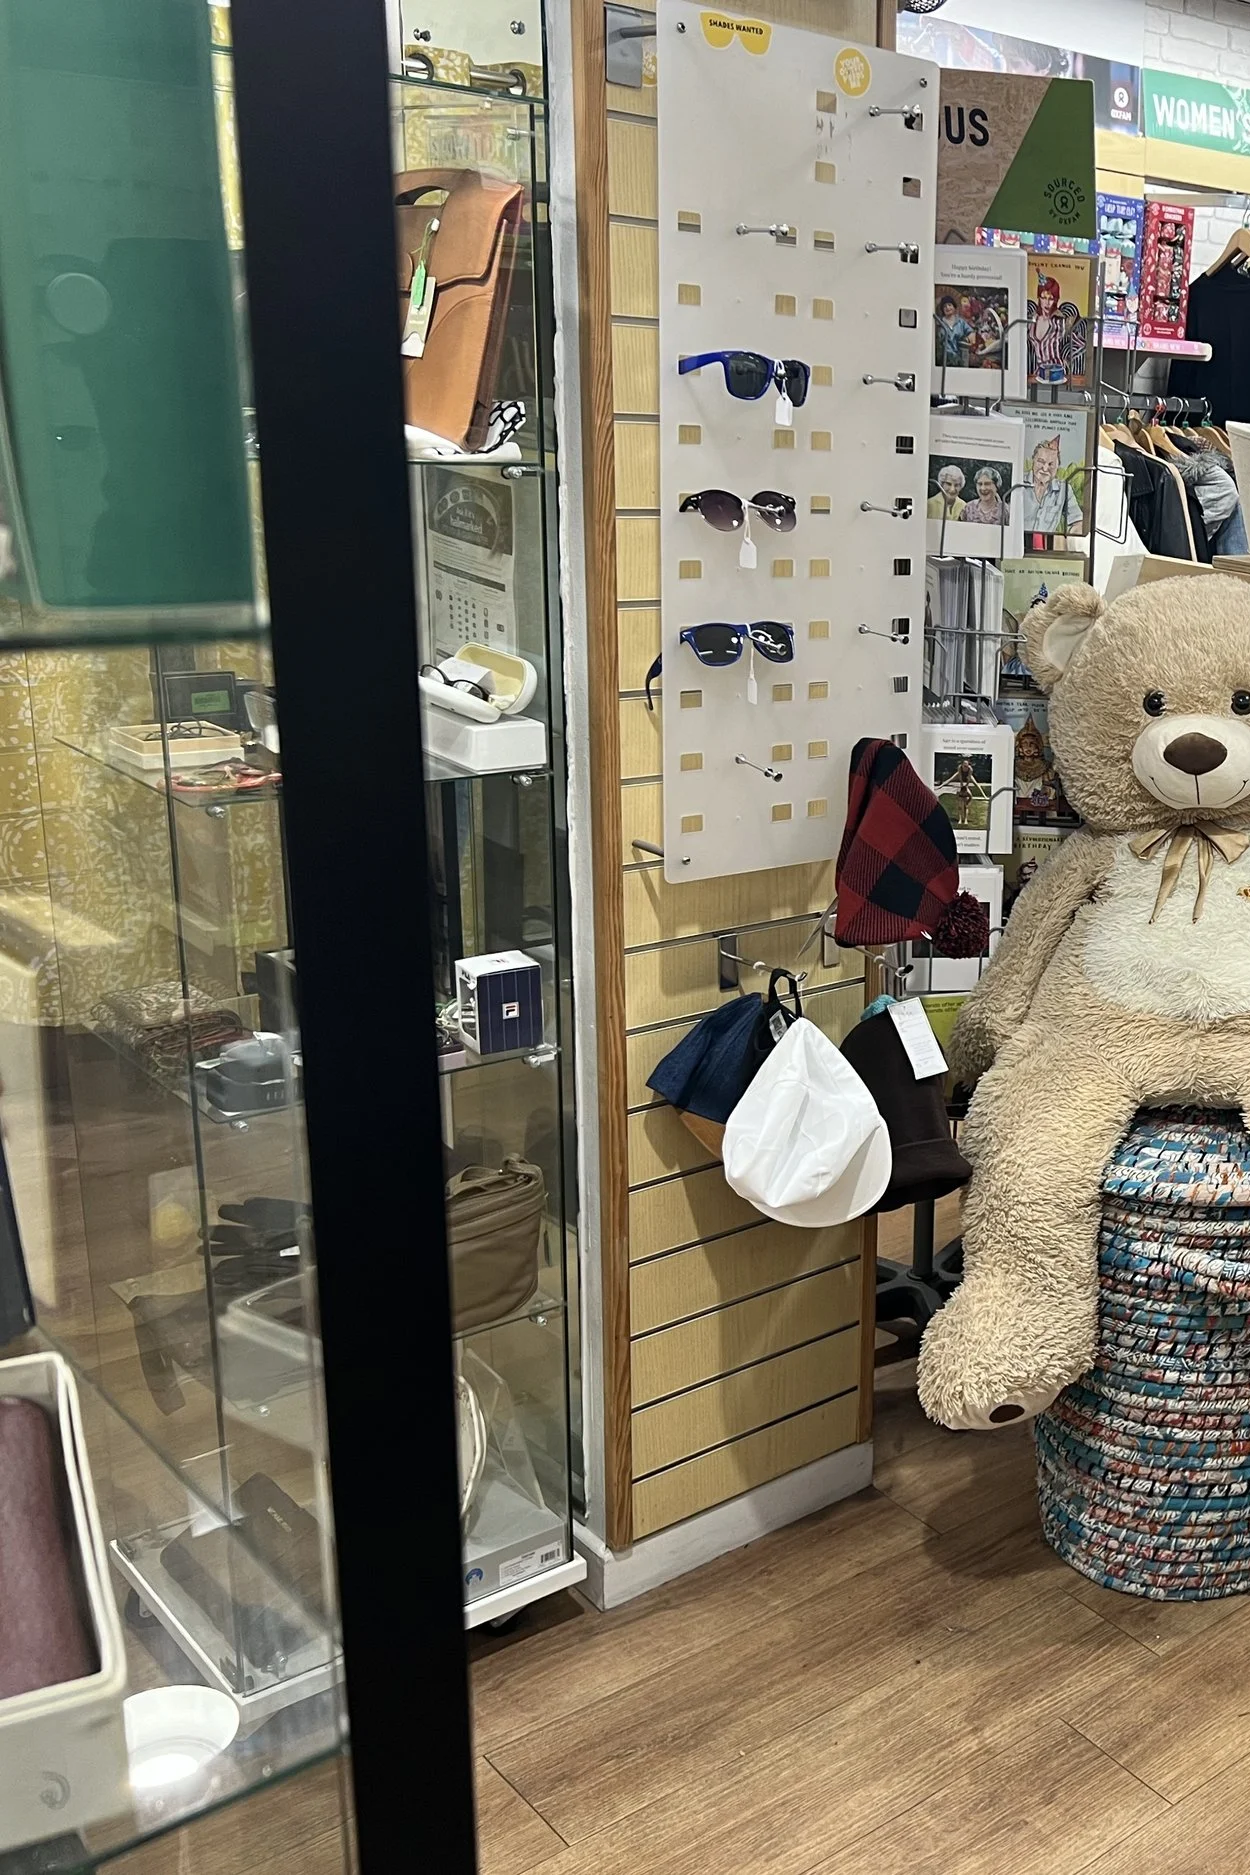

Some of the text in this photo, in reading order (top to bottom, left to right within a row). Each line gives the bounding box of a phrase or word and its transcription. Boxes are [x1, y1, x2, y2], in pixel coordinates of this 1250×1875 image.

[709, 19, 764, 36] SHADES WANTED
[938, 105, 990, 147] US
[1043, 177, 1086, 204] SOURCED
[1058, 210, 1082, 225] OXFAM
